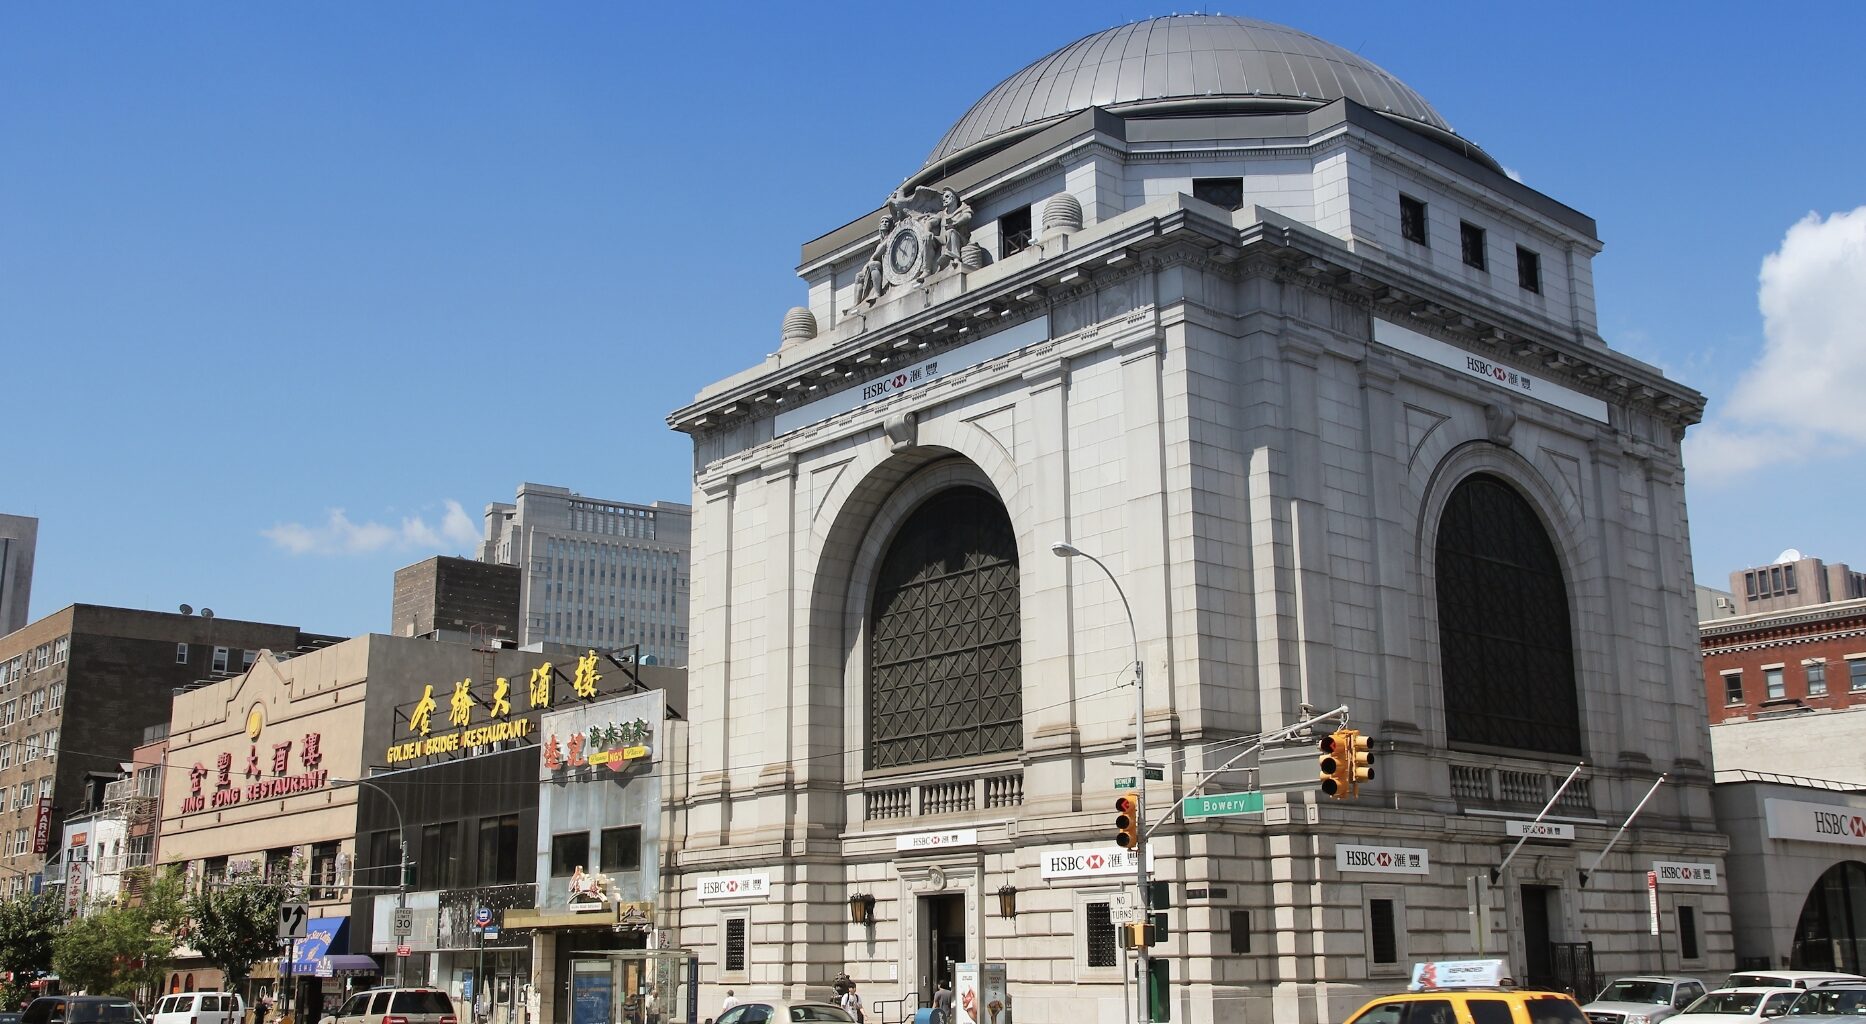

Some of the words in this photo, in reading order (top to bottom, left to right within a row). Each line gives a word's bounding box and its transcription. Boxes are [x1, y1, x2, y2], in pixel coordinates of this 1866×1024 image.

[1466, 357, 1493, 376] HSBC
[863, 380, 891, 400] HSBC
[410, 650, 602, 736] 金橋大酒樓
[387, 739, 422, 763] GOLDEN
[425, 733, 459, 756] BRIDGE
[463, 718, 528, 748] RESTAURANT
[1115, 777, 1134, 785] BOWERY
[181, 795, 205, 814] JING
[211, 788, 241, 808] FONG
[247, 769, 328, 801] RESTAURANT
[1203, 800, 1245, 811] Bowery
[37, 807, 49, 838] PARK
[1814, 811, 1849, 835] HSBC
[913, 837, 931, 846] HSBC
[1051, 856, 1085, 871] HSBC
[1346, 851, 1376, 866] HSBC
[1661, 867, 1680, 879] HSBC
[704, 881, 725, 893] HSBC
[1112, 910, 1132, 919] TURNS
[396, 919, 411, 928] 30
